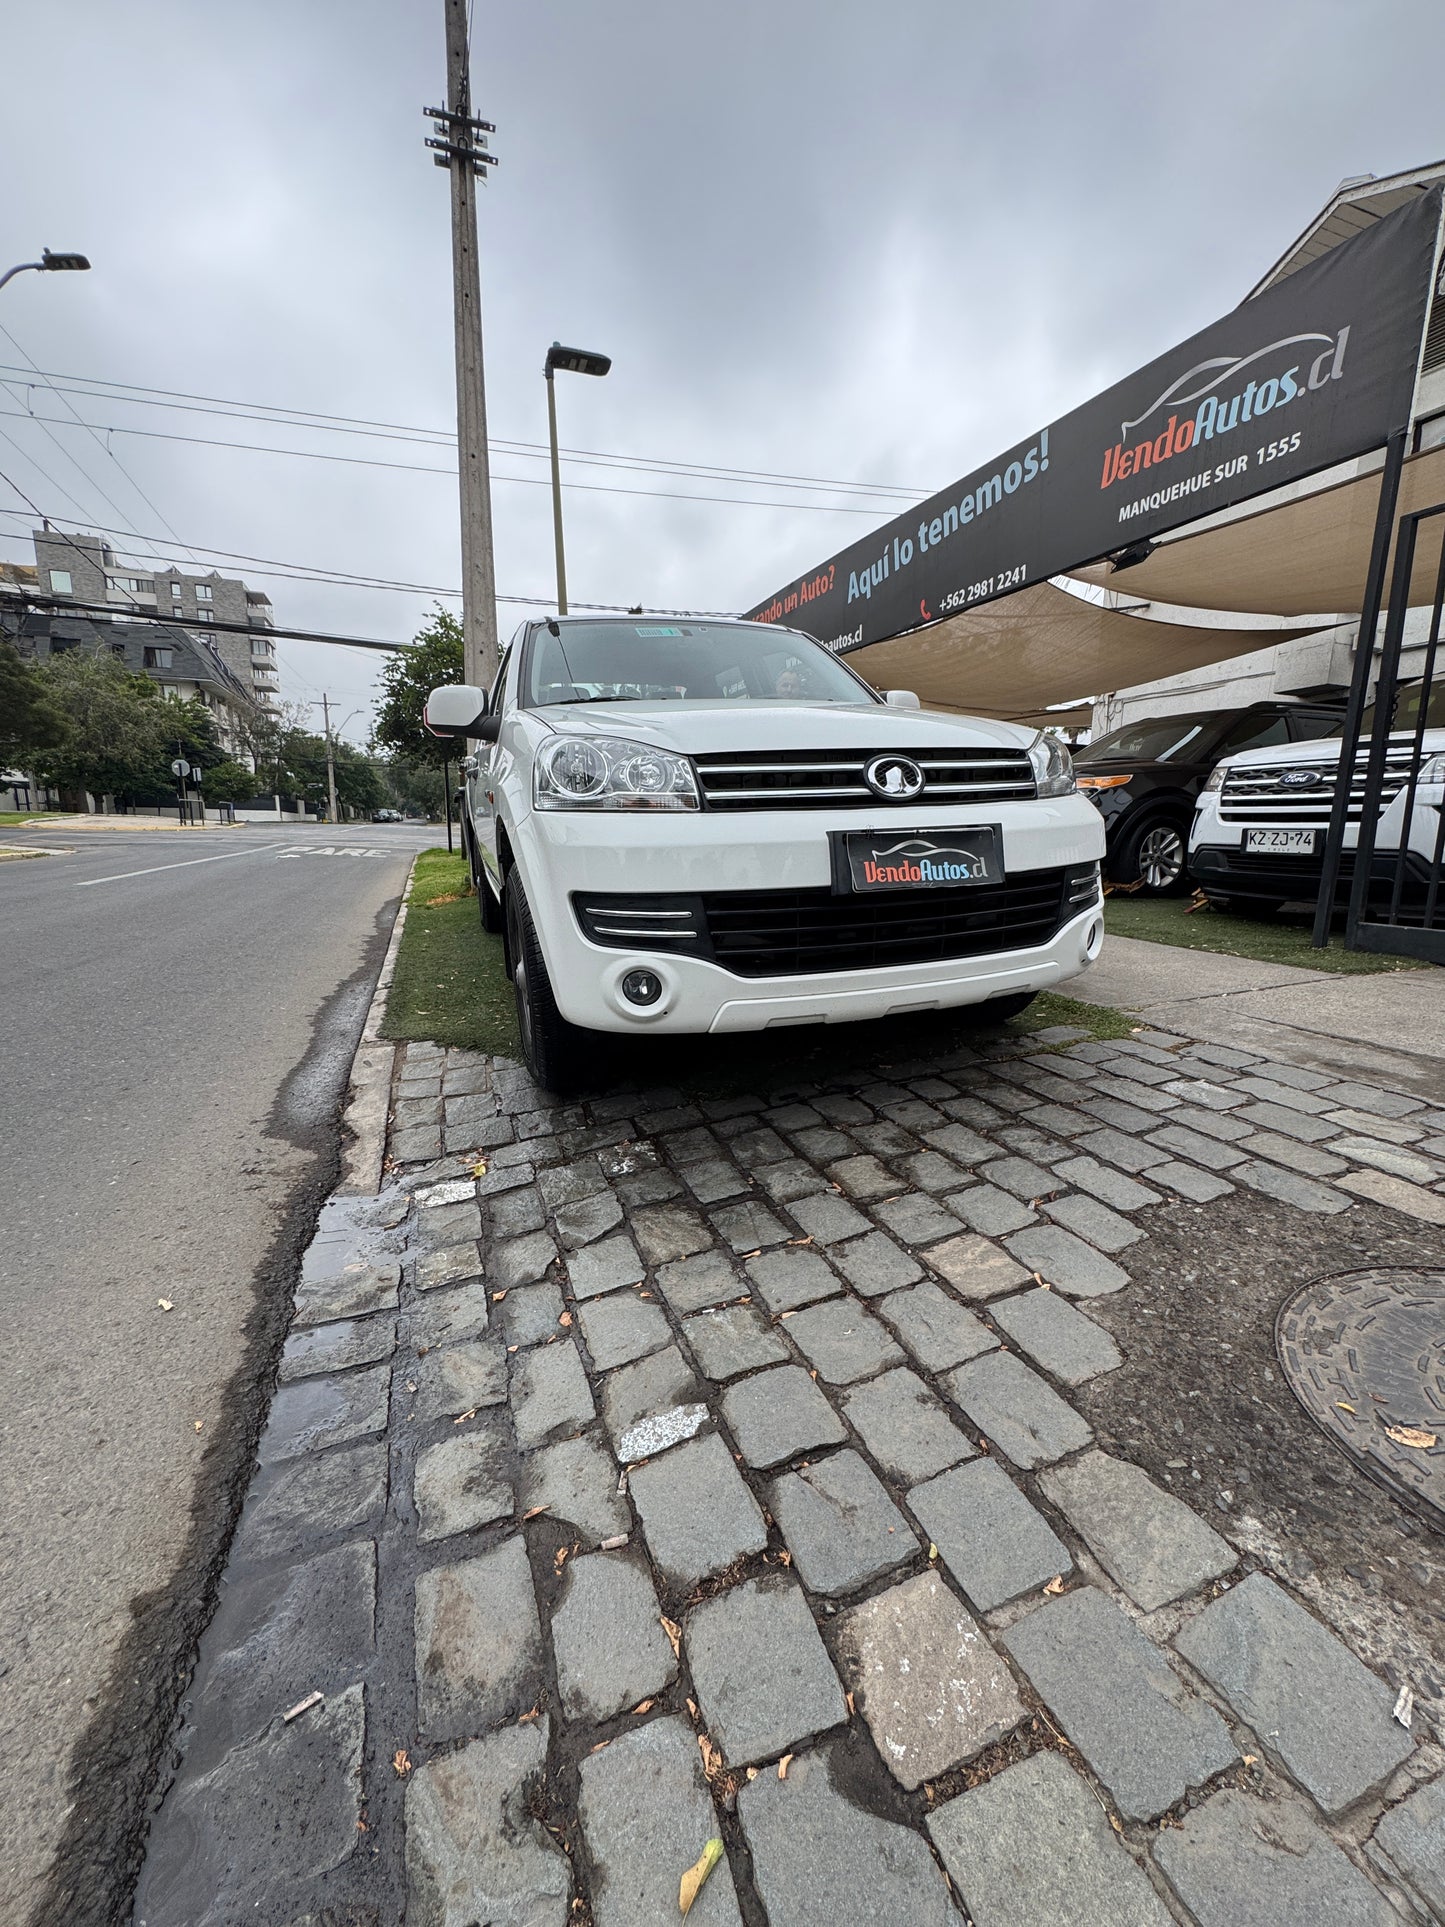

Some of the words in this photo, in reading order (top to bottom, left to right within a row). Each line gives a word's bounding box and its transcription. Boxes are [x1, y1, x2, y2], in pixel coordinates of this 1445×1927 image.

[1100, 325, 1350, 489] VendoAutos.cl
[1118, 469, 1211, 522] MANQUEHUE
[1214, 455, 1248, 483] SUR
[1256, 432, 1302, 465] 1555
[847, 544, 889, 604] Aquí
[893, 536, 914, 572] lo
[918, 428, 1049, 553] tenemos!
[784, 592, 798, 613] un
[800, 564, 835, 605] Auto?
[939, 589, 966, 611] +562
[966, 577, 993, 602] 2981
[996, 564, 1027, 592] 2241
[1284, 773, 1309, 783] Ford
[275, 846, 391, 858] PARE
[864, 857, 988, 883] VendoAutos.cl
